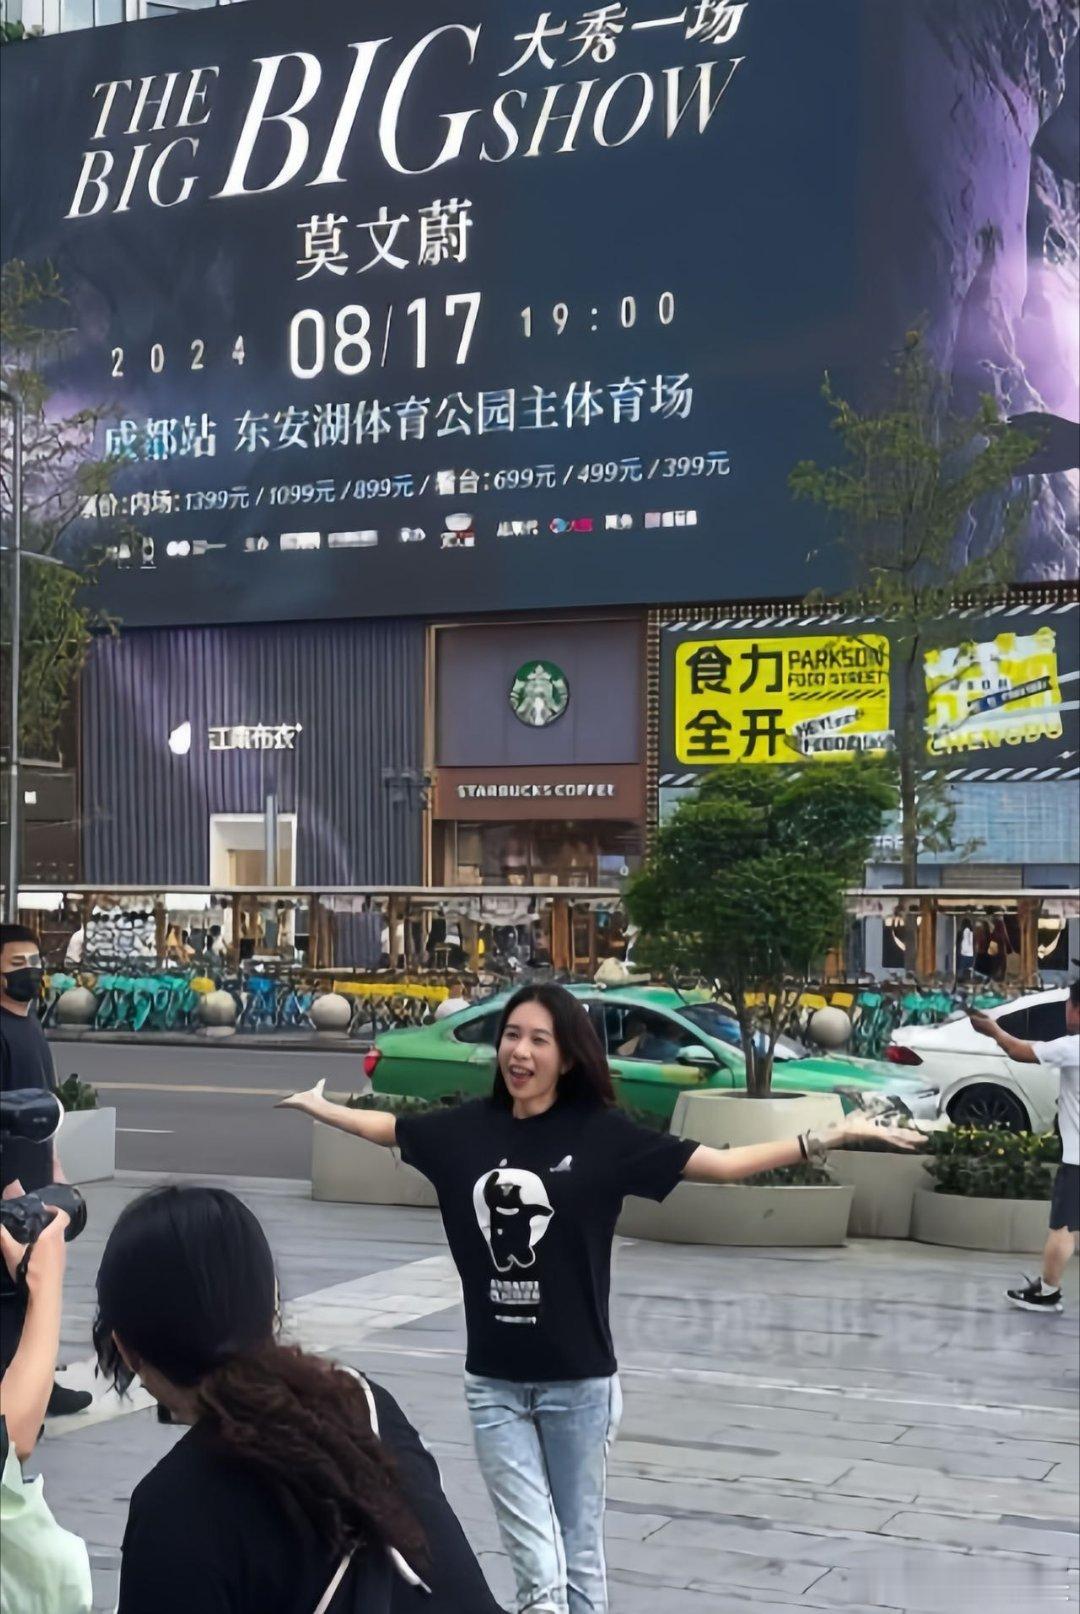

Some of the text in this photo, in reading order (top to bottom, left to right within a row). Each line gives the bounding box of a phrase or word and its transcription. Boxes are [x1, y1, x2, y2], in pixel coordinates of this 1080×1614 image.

[498, 2, 748, 77] 大秀一场
[90, 66, 220, 140] THE
[211, 24, 746, 200] BIG SHOW
[65, 138, 200, 219] BIG
[296, 198, 473, 281] 莫文蔚
[111, 291, 675, 379] 2024 08/17 19:00
[105, 373, 694, 461] 成都站 东安湖体育公园主体育场
[686, 643, 782, 695] 食力
[788, 645, 884, 670] PARKSON
[686, 709, 785, 757] 全开
[457, 785, 552, 798] STARBUCKS
